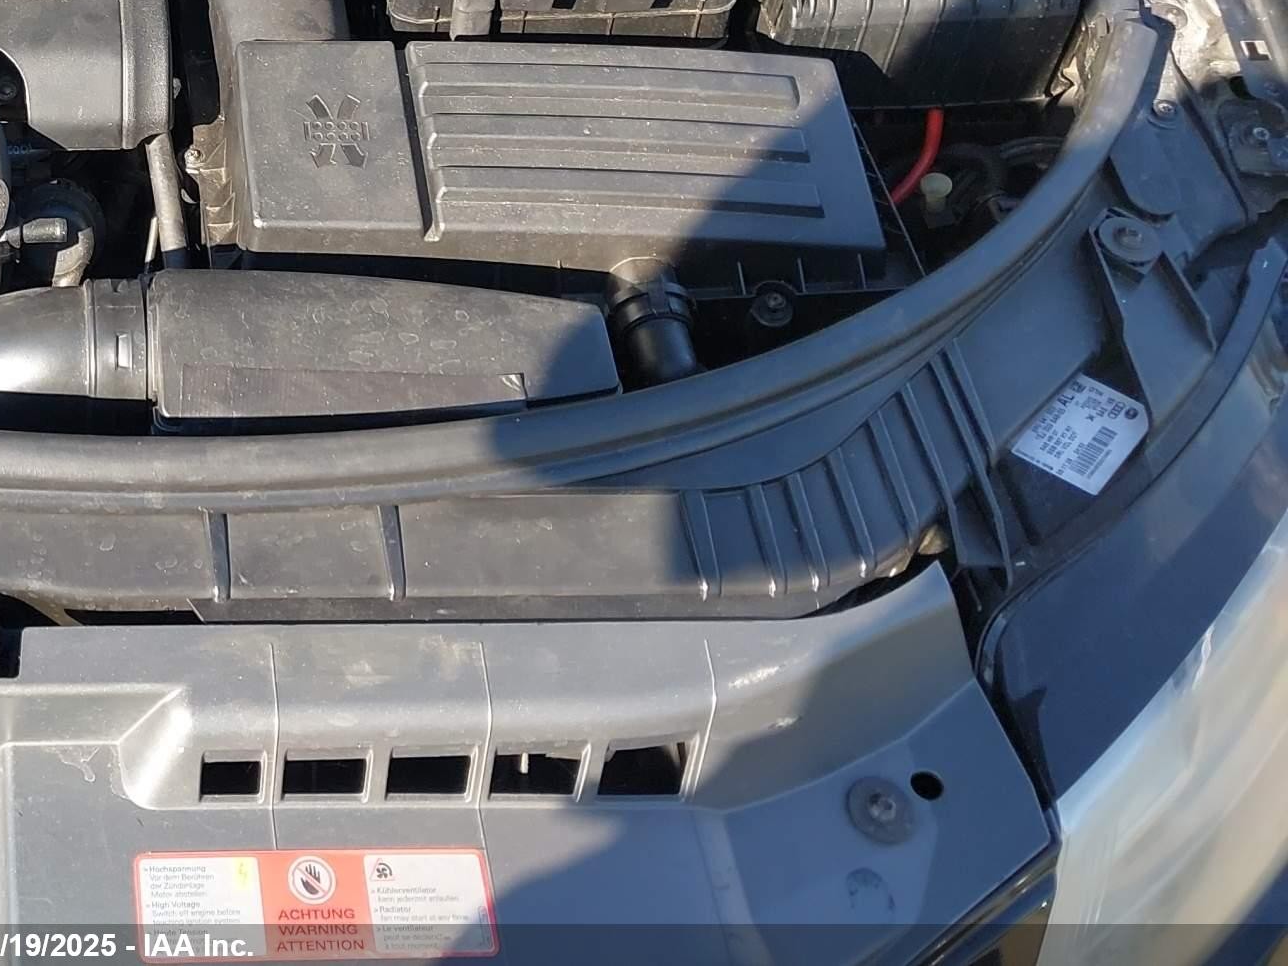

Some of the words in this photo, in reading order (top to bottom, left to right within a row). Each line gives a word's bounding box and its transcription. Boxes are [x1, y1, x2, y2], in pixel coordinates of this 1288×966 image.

[1057, 394, 1075, 406] AL
[149, 865, 206, 874] Hochspannung
[152, 902, 170, 910] High
[171, 901, 200, 910] Voltage
[191, 910, 216, 918] engine
[278, 908, 356, 921] ACHTUNG
[278, 923, 358, 935] WARNING
[394, 924, 433, 932] ventilateur
[276, 939, 365, 952] ATTENTION
